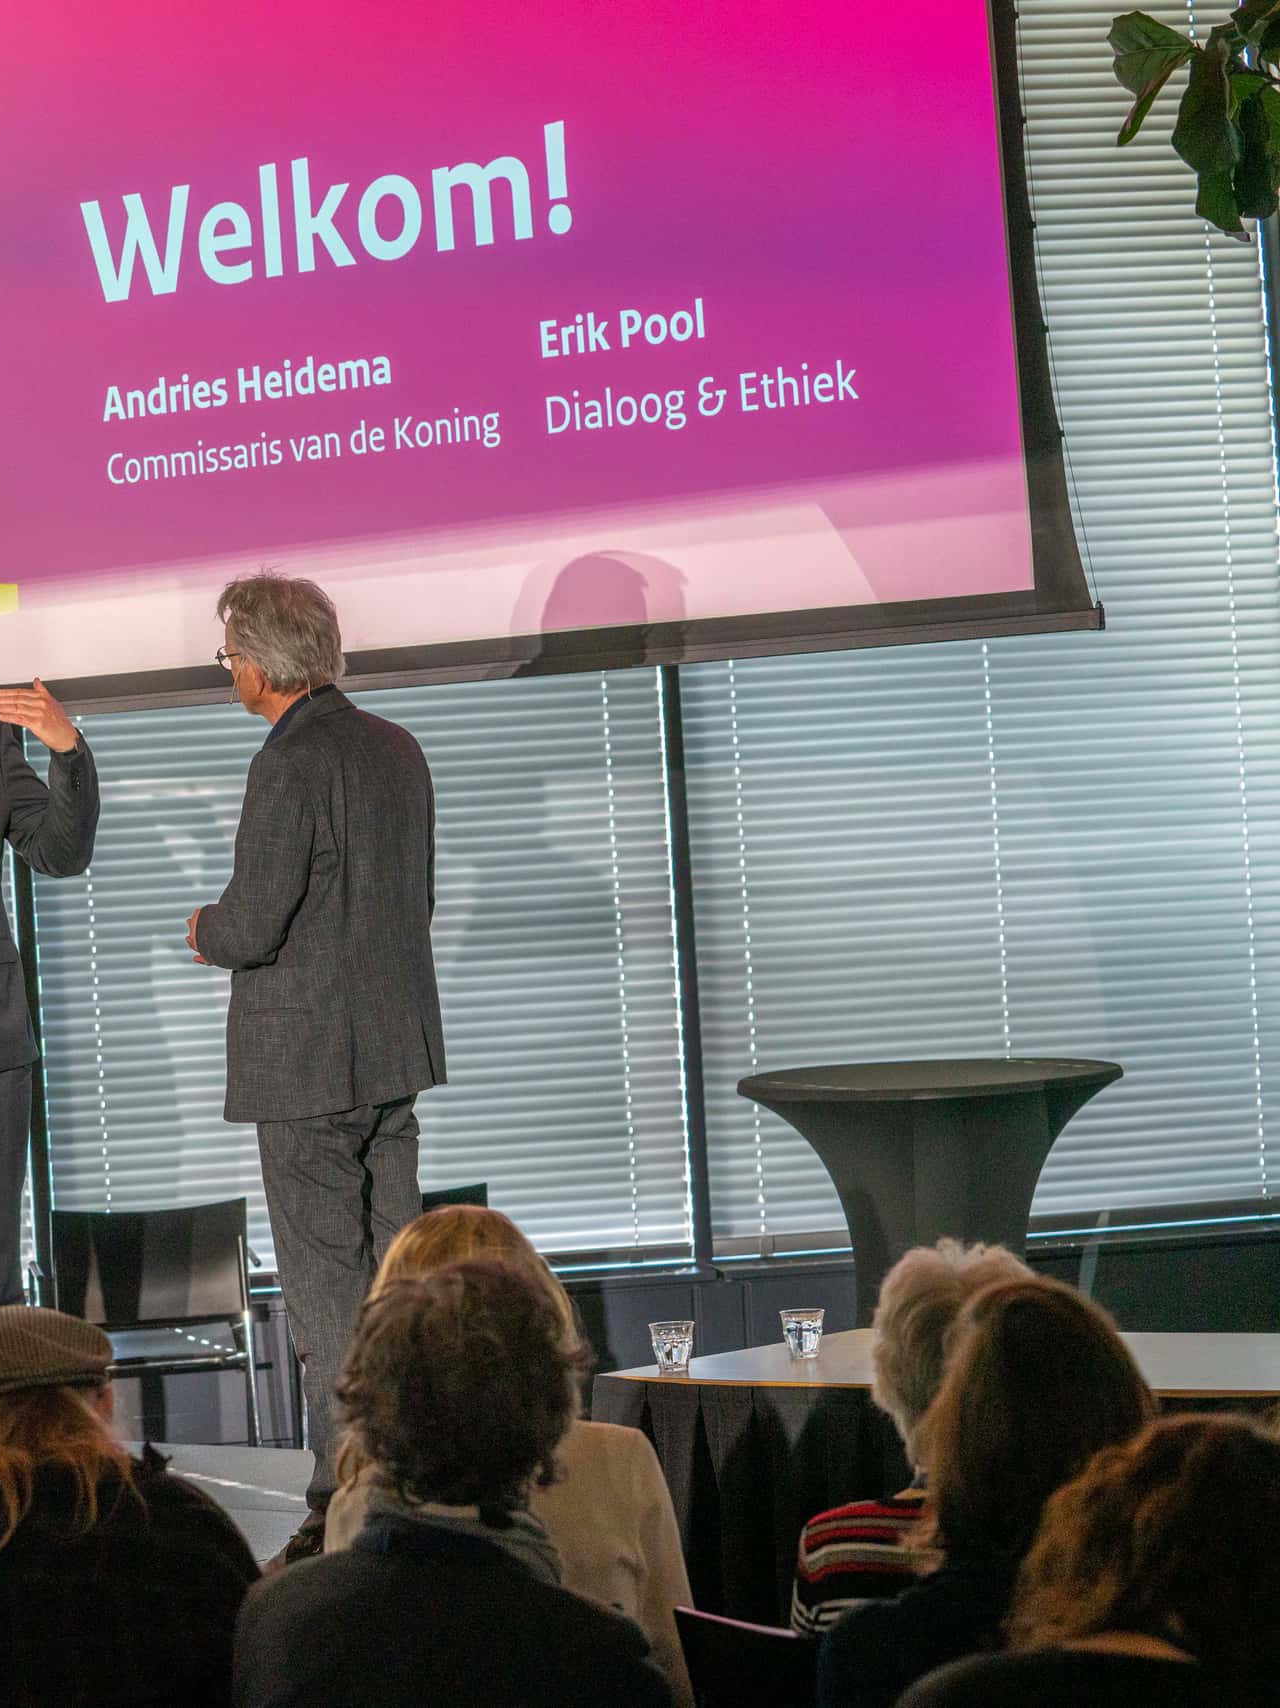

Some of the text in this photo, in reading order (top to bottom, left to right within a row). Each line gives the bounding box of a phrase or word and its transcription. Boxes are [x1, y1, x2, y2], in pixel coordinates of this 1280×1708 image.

[79, 120, 574, 305] Welkom!
[538, 297, 706, 359] Erik Pool
[103, 354, 393, 422] Andries Heidema
[545, 359, 859, 434] Dialoog & Ethiek
[106, 406, 502, 485] Commissaris van de Koning
